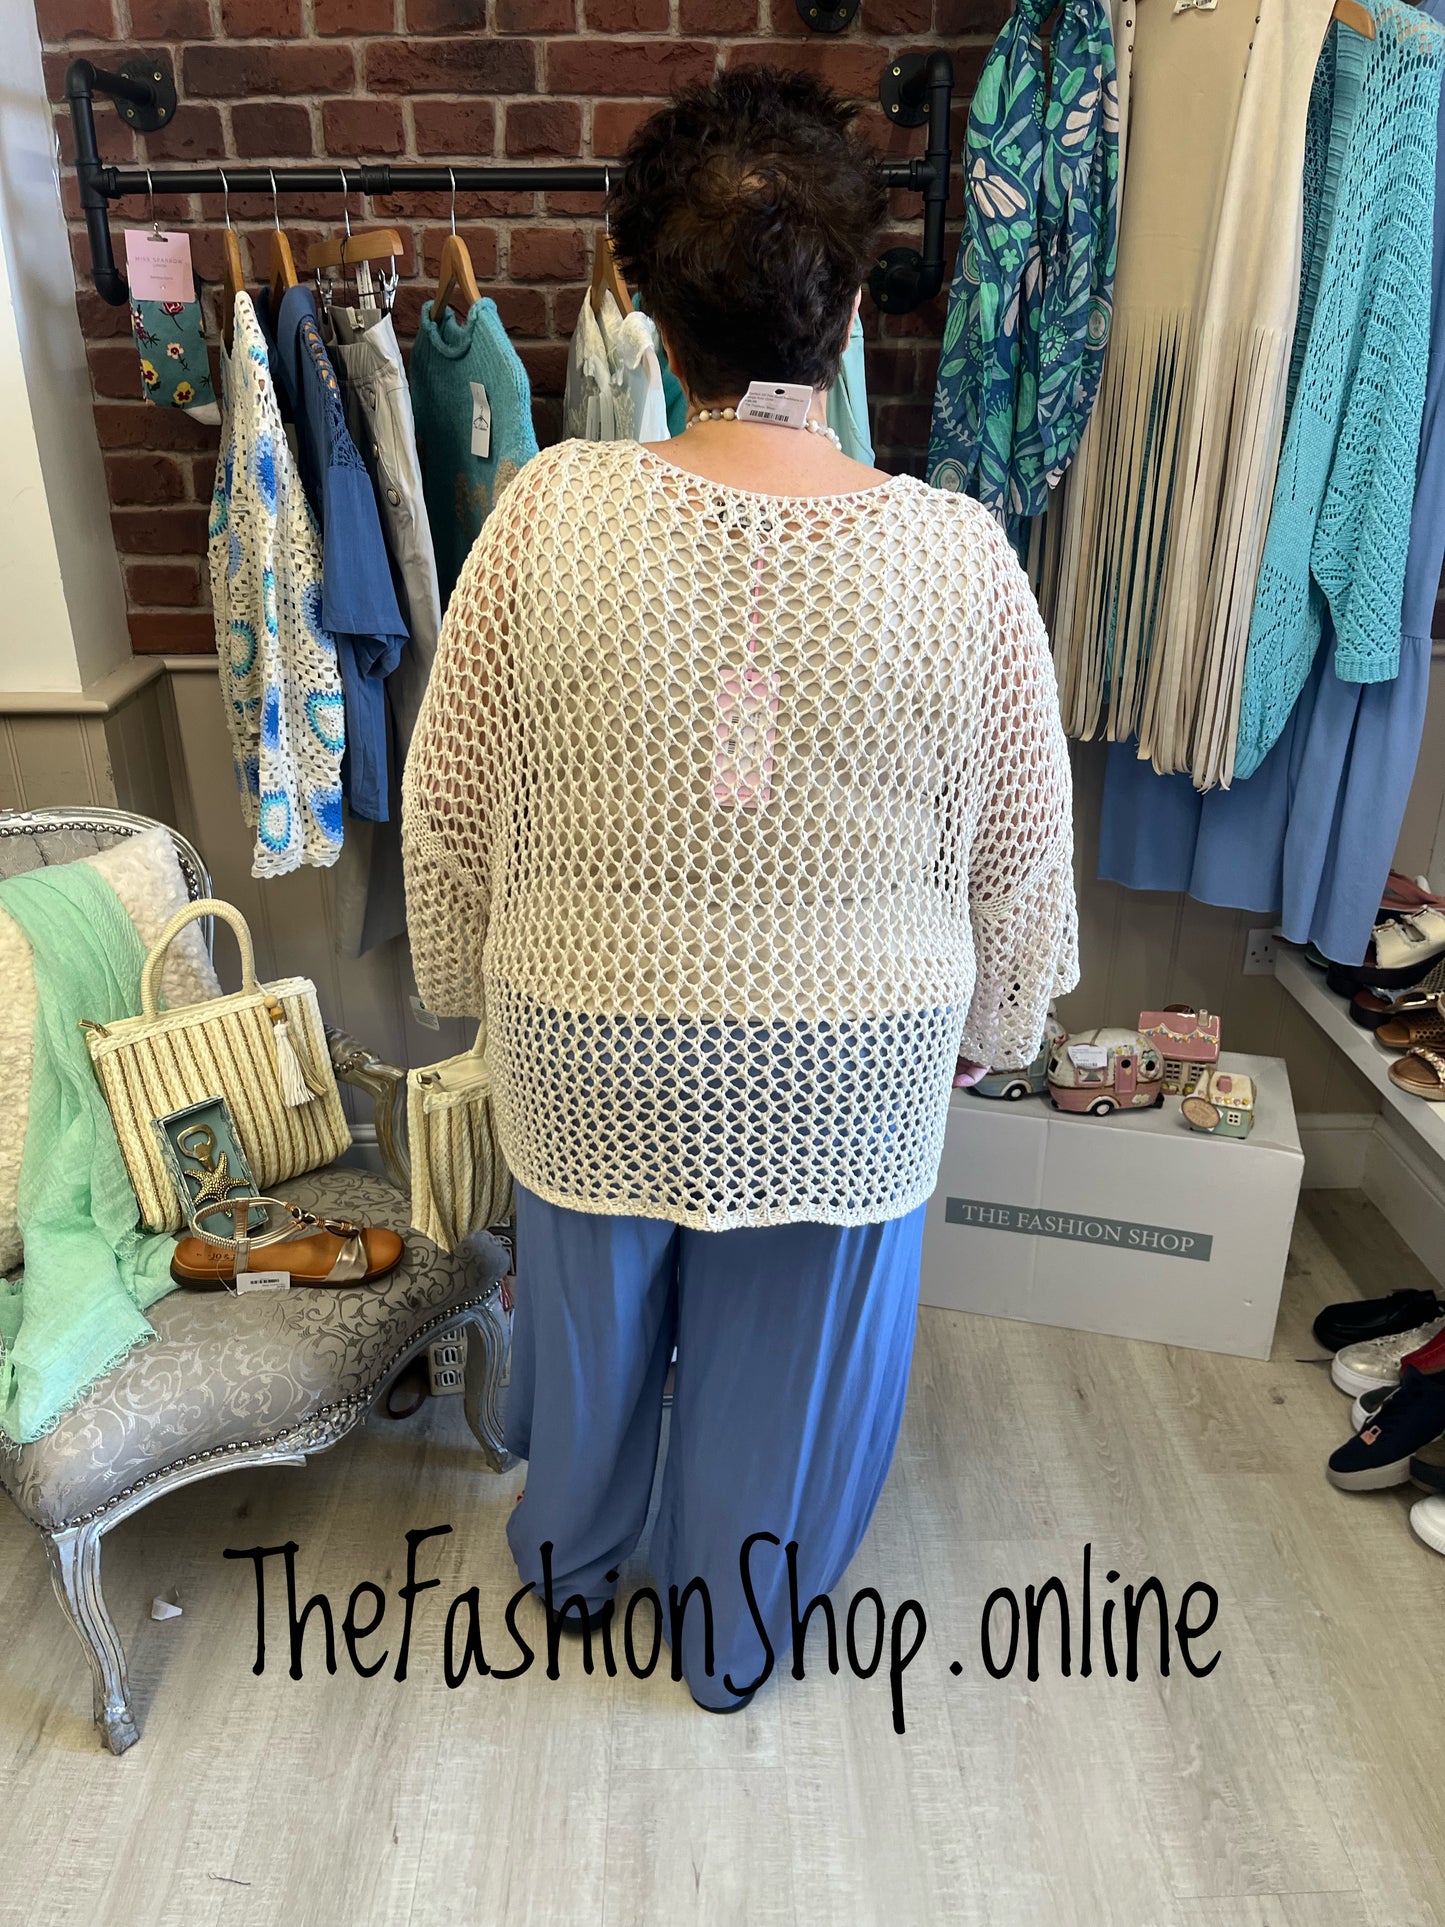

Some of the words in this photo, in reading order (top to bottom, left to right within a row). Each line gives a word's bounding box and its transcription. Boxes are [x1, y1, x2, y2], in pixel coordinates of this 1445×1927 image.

[962, 1204, 1010, 1226] THE
[1016, 1211, 1122, 1242] FASHION
[1128, 1228, 1195, 1252] SHOP
